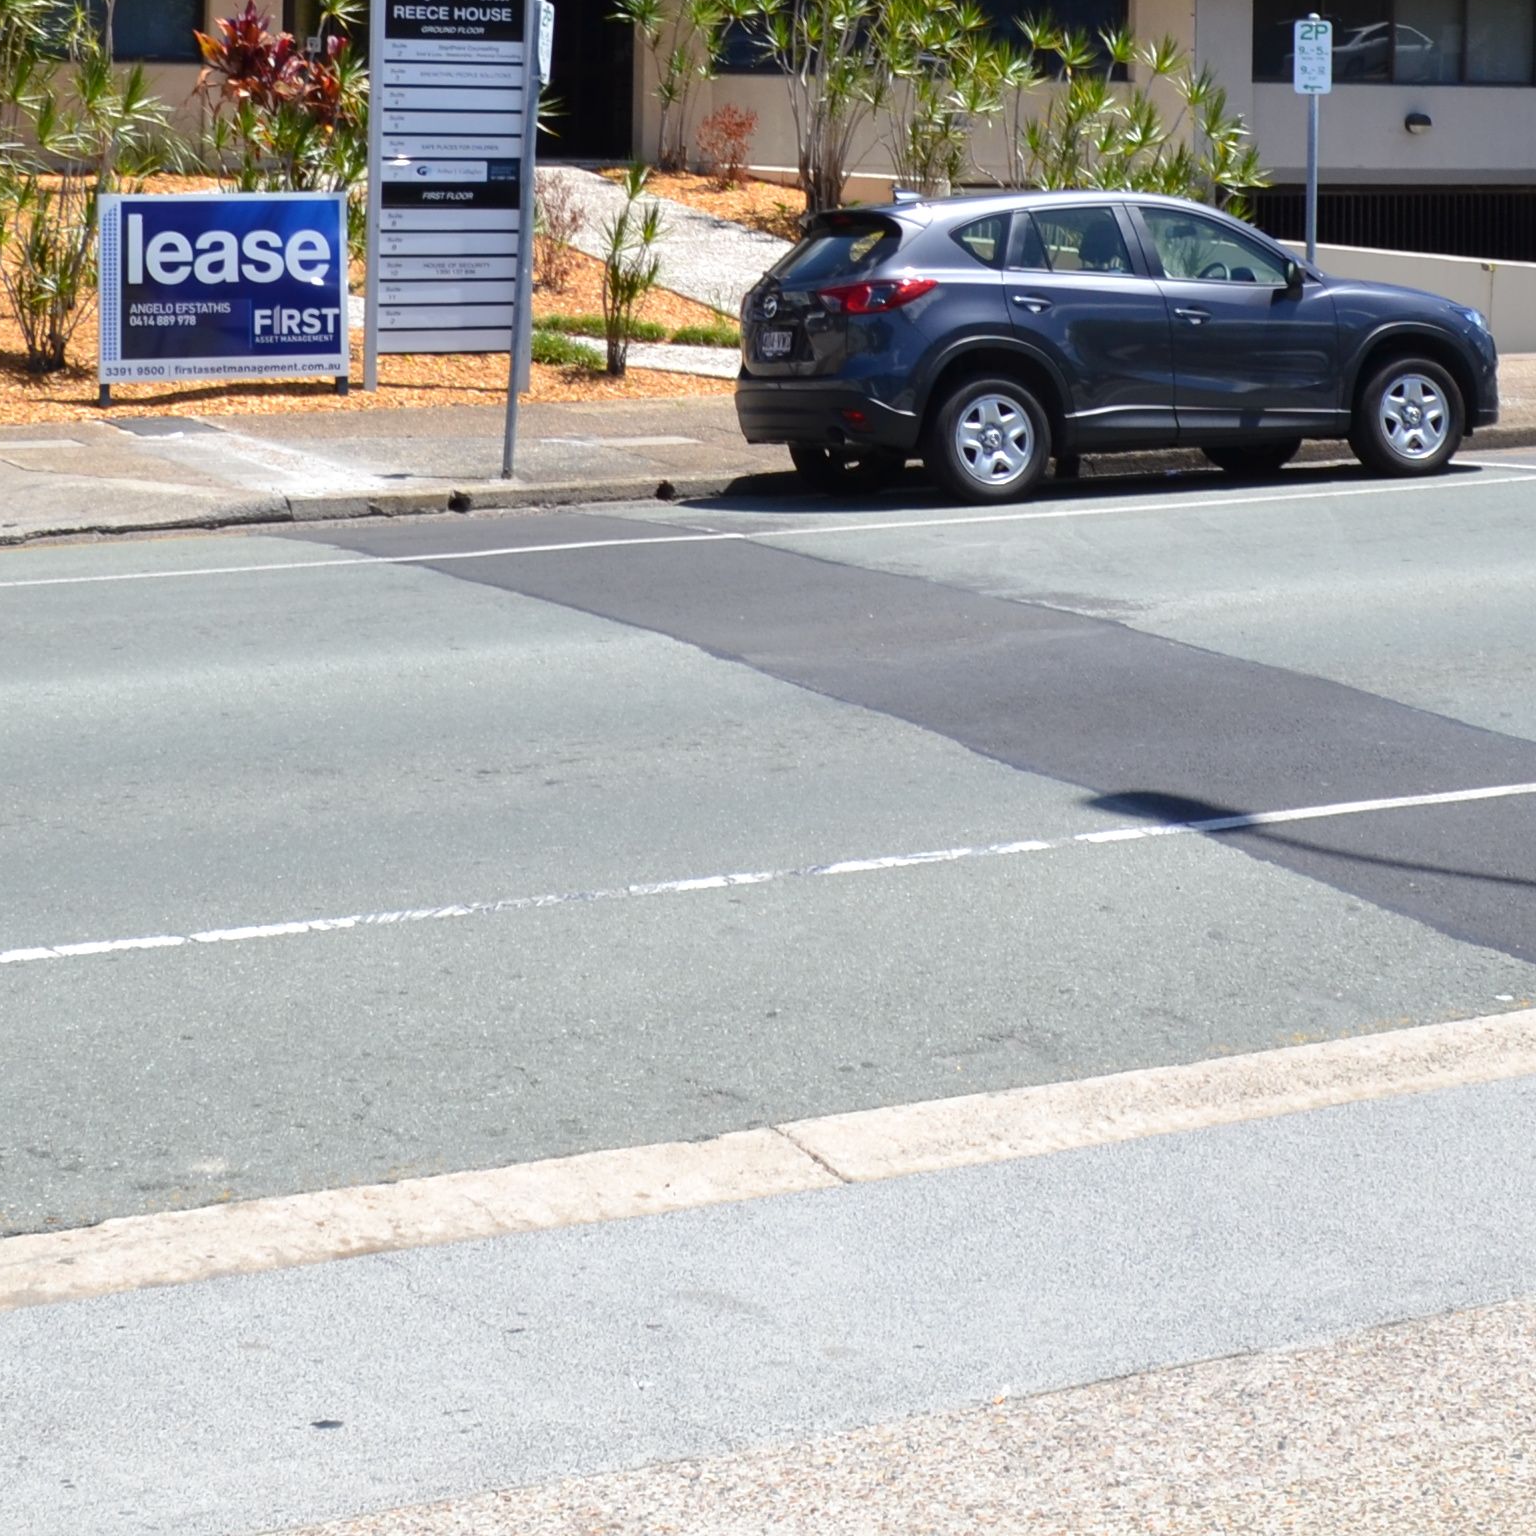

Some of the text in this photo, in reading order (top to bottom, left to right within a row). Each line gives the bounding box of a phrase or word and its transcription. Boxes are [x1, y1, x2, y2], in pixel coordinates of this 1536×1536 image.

[393, 5, 512, 22] REECE HOUSE
[421, 25, 485, 35] GROUND FLOOR
[1300, 23, 1329, 41] 2P
[422, 192, 474, 201] FIRST FLOOR
[128, 213, 332, 285] lease
[129, 302, 231, 314] ANGELO EFSTATHIS
[129, 314, 197, 327] 0414 889 978
[254, 304, 340, 336] FIRST
[255, 334, 334, 344] ASSET MANAGEMENT
[105, 362, 341, 377] 3391 9500 firstassetmanagement.com.au
